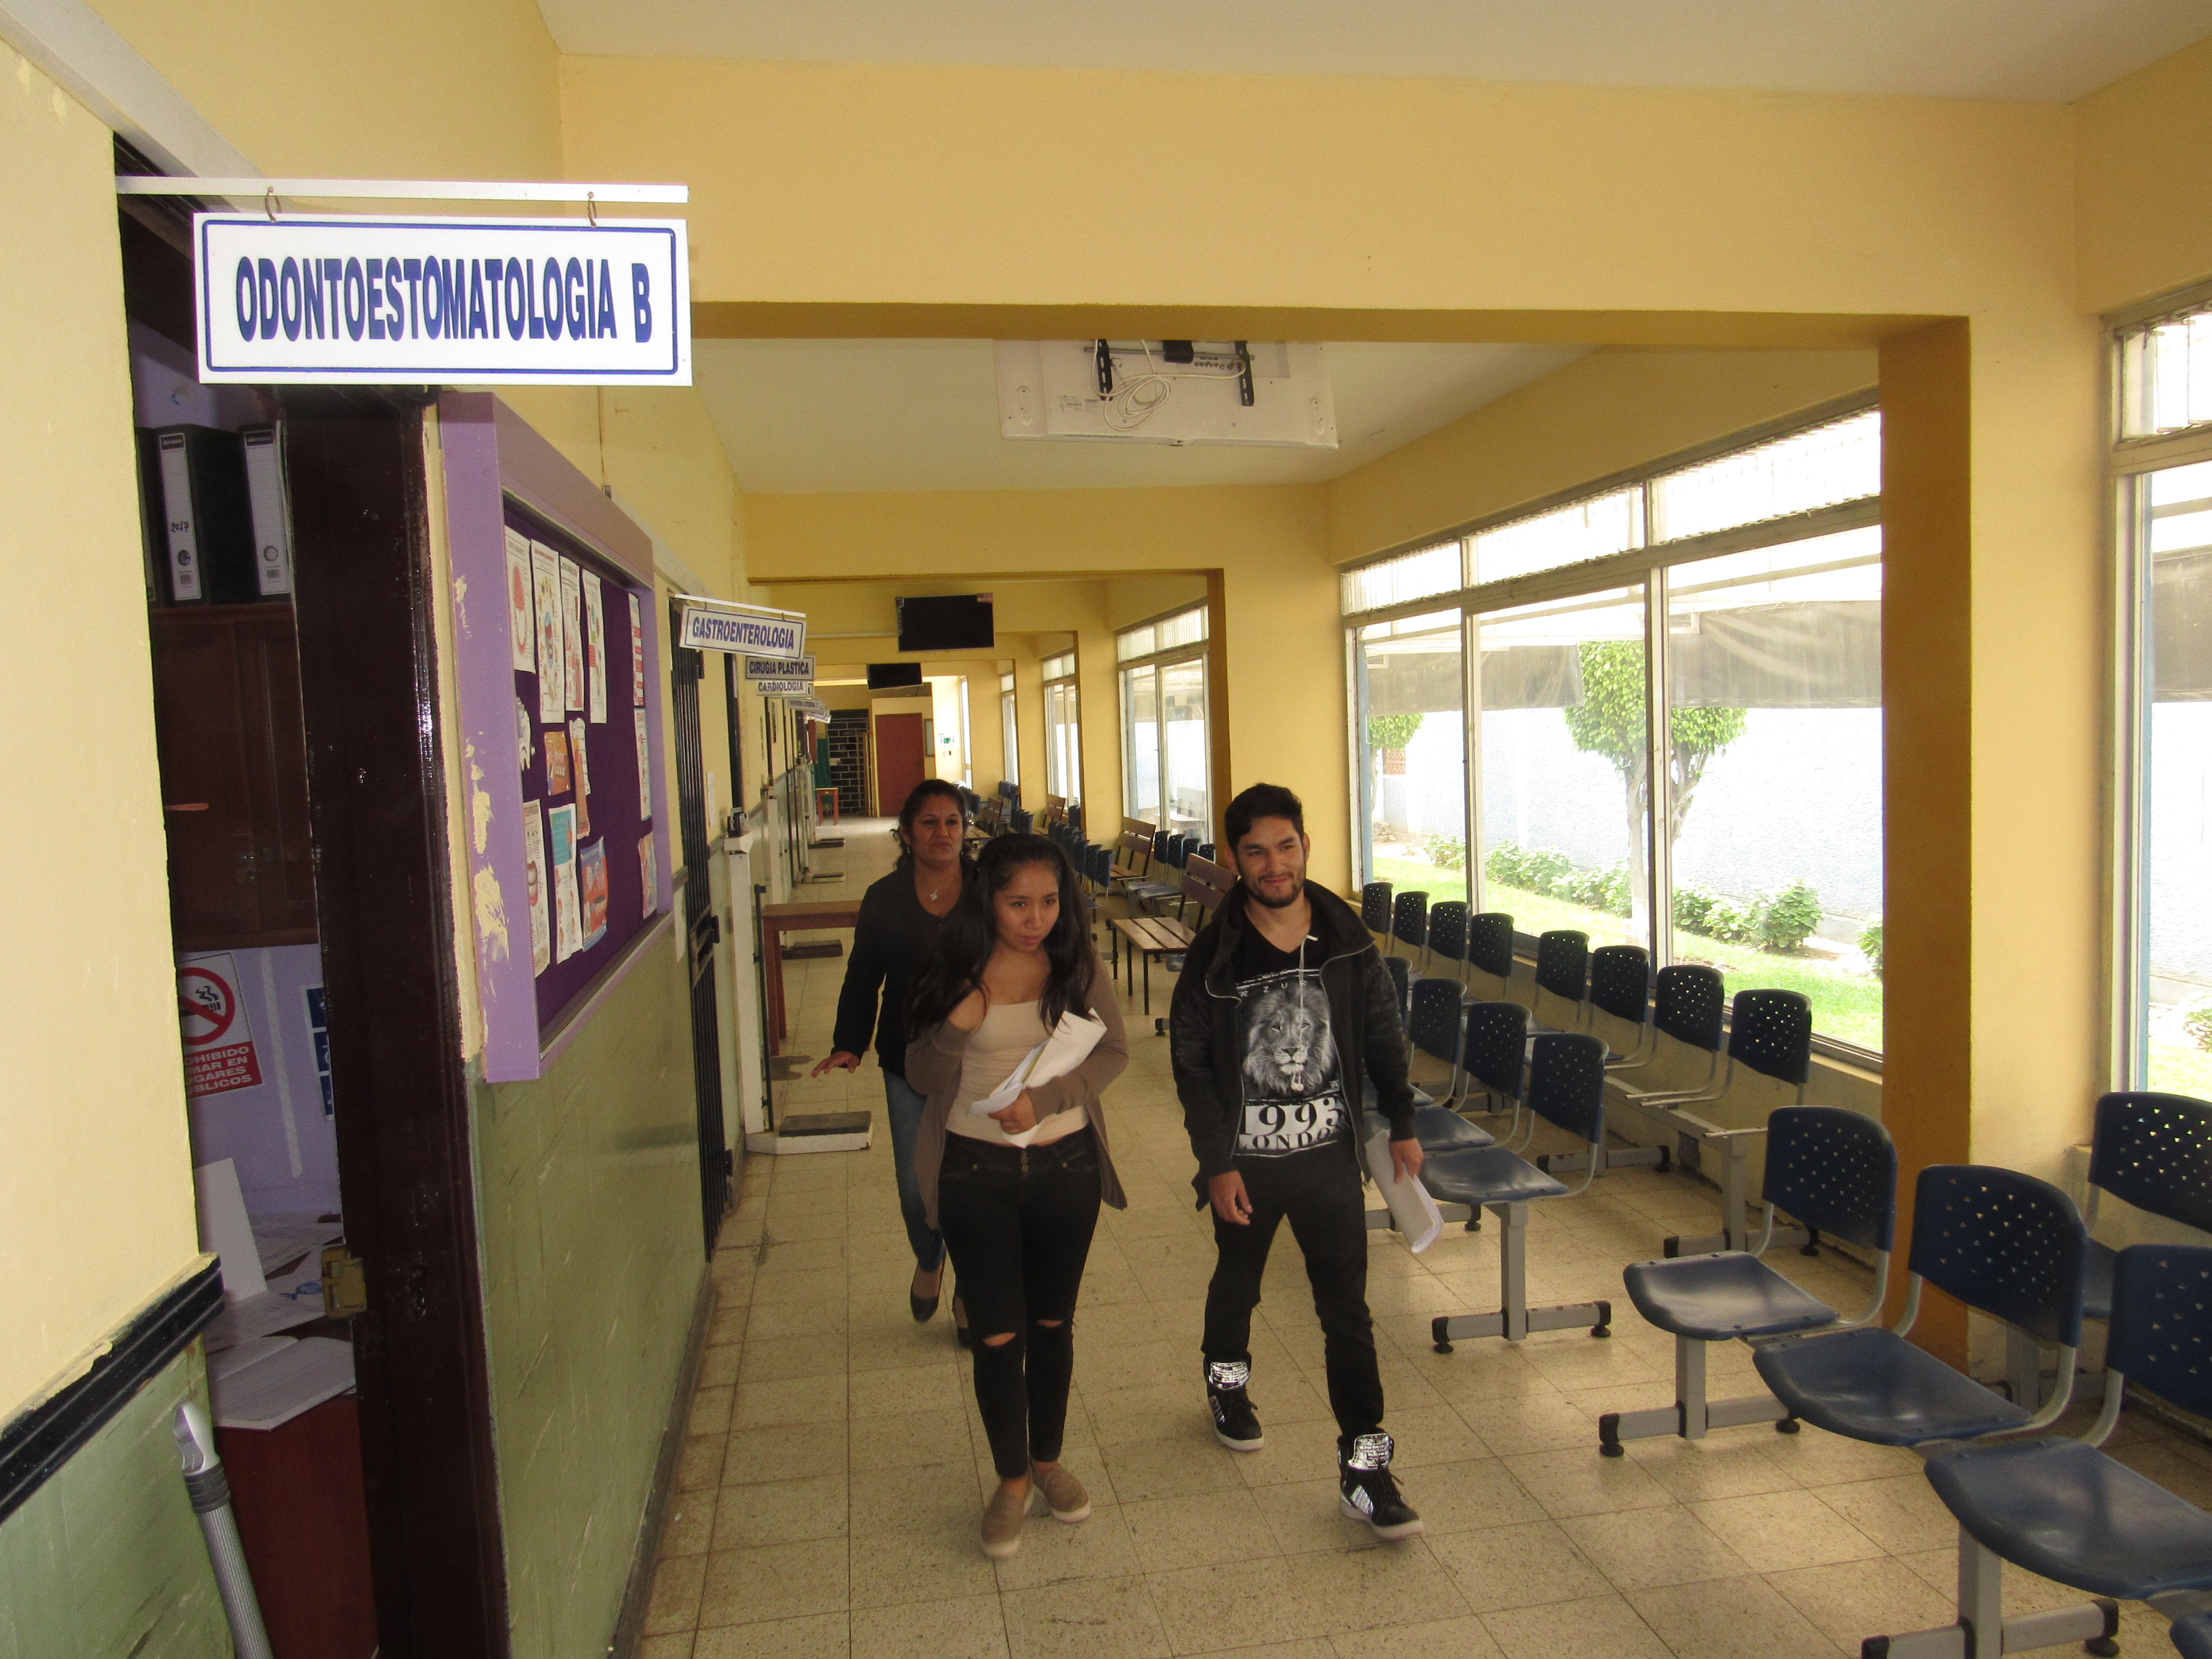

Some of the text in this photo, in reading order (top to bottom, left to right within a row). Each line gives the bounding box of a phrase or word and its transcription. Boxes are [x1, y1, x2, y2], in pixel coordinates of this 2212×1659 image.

[236, 255, 652, 343] ODONTOESTOMATOLOGIA B
[693, 617, 794, 649] GASTROENTEROLOGIA
[750, 661, 809, 675] CIRUGIA PLASTICA
[758, 681, 804, 692] CARDIOLOGIA
[186, 1046, 249, 1066] OHIBIDO
[227, 1056, 249, 1067] EN
[192, 1066, 247, 1083] GARES
[193, 1074, 253, 1092] BLICOS
